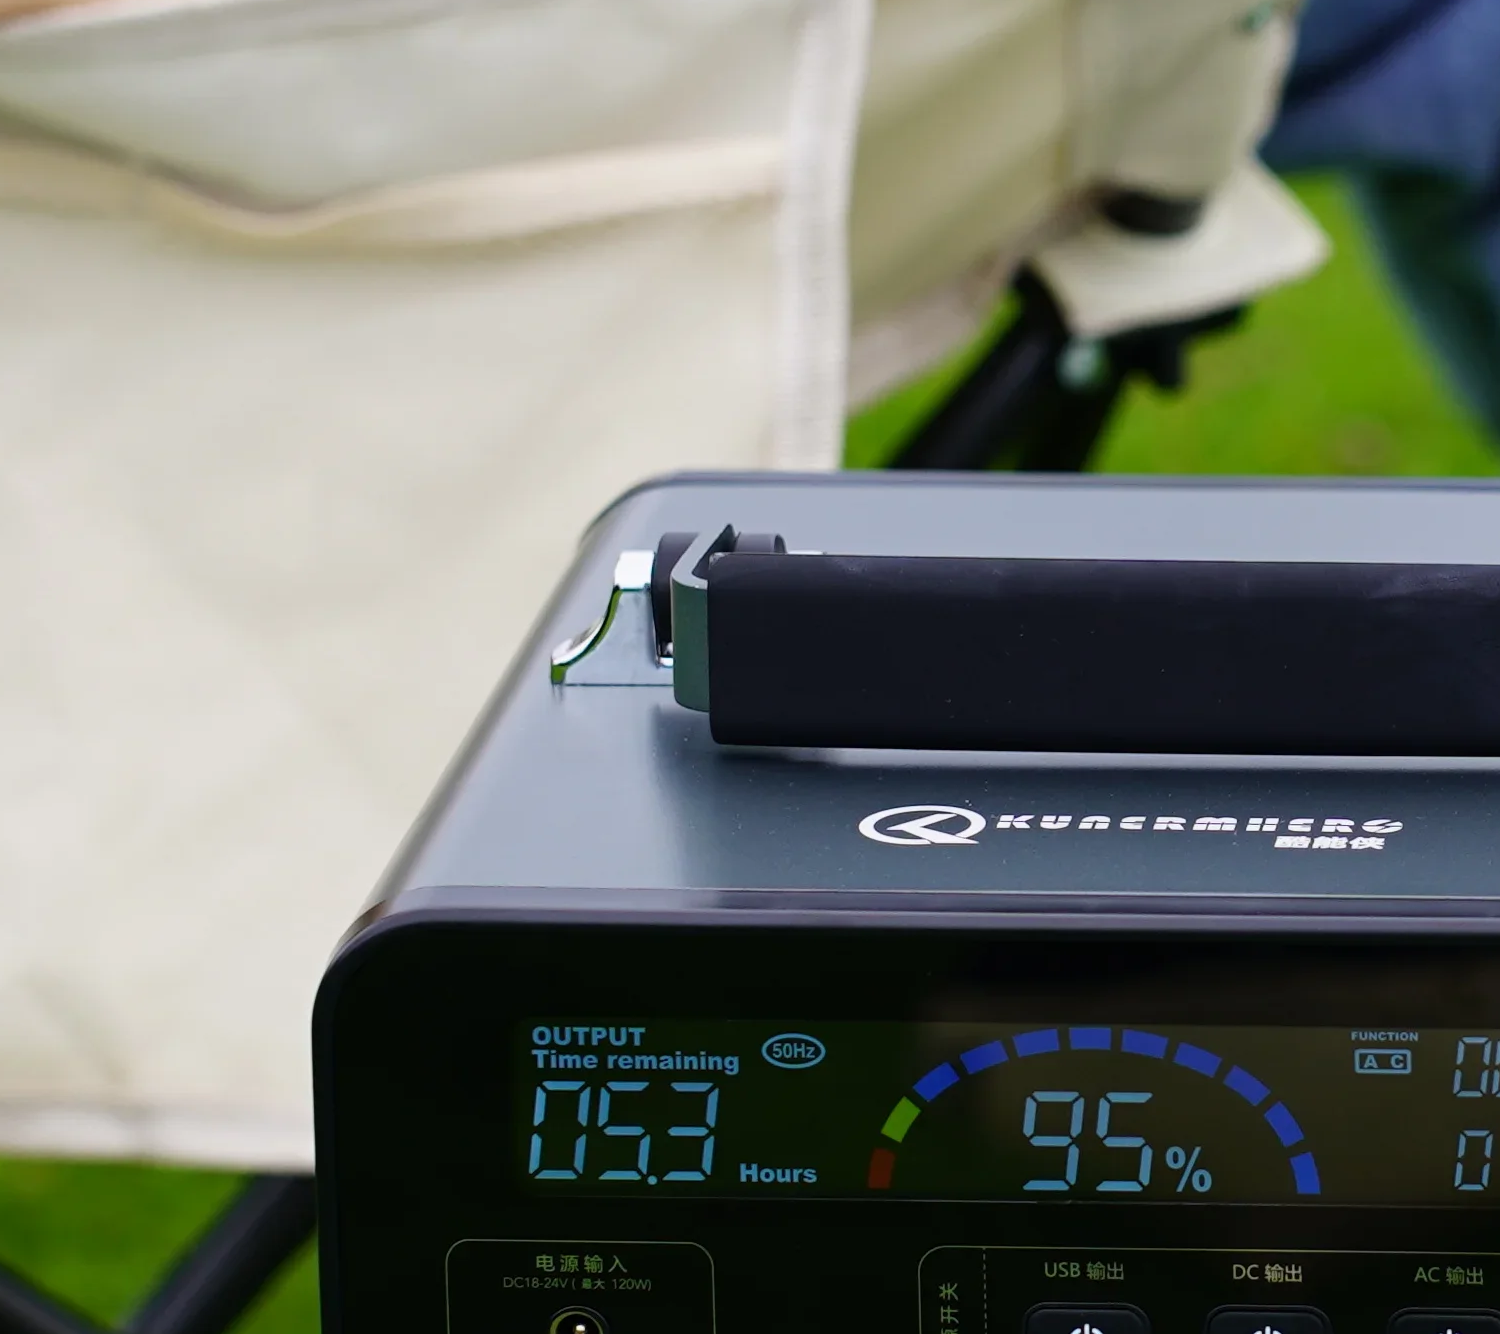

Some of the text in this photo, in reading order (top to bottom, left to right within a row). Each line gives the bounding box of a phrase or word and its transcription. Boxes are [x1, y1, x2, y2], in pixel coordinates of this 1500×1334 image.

[533, 1027, 645, 1046] OUTPUT
[1351, 1032, 1418, 1041] FUNCTION
[772, 1042, 816, 1059] 50Hz
[532, 1049, 739, 1075] Time remaining
[740, 1164, 817, 1182] Hours
[536, 1255, 627, 1273] 电源输入
[1045, 1262, 1124, 1280] USB 输出
[1233, 1264, 1302, 1282] DC 输出
[1414, 1266, 1483, 1285] AC 输出
